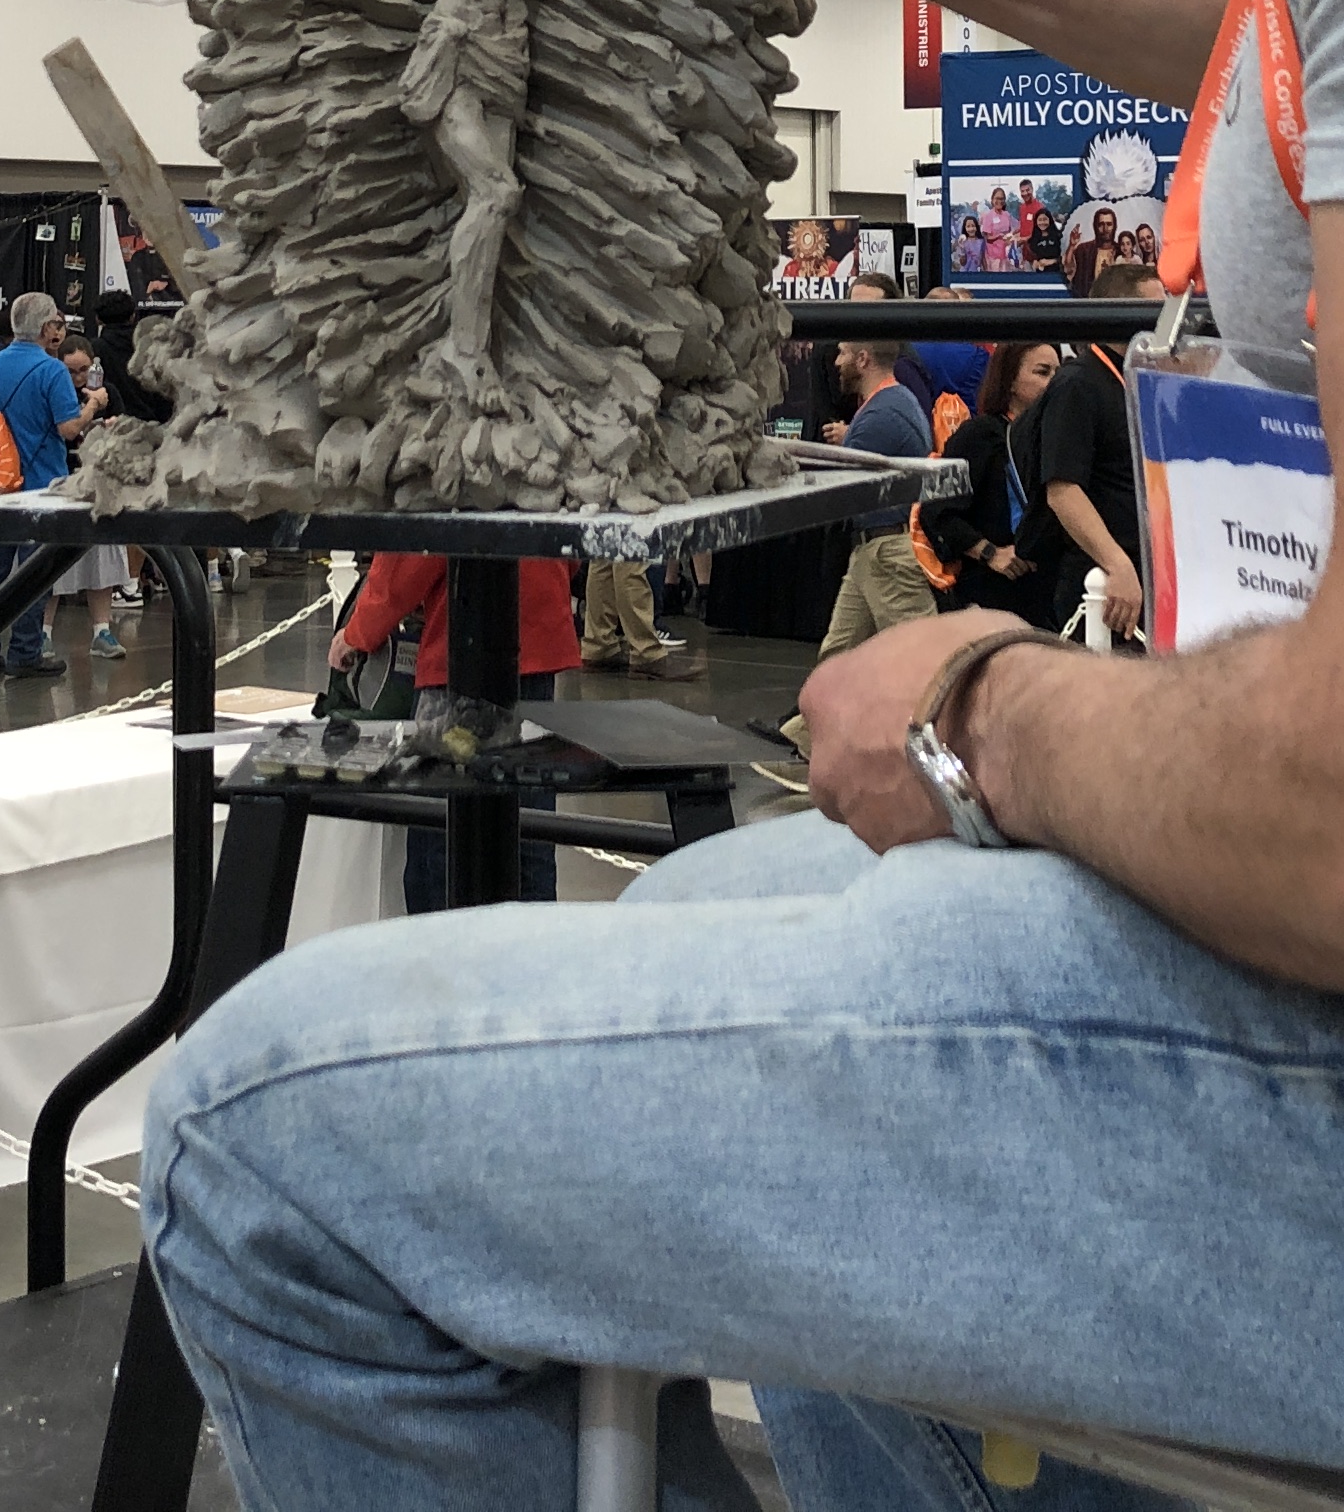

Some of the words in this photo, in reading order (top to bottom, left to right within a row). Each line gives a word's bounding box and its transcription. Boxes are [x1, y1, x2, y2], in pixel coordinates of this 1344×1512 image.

[1001, 72, 1122, 97] APOSTOL
[961, 100, 1052, 128] FAMILY
[1057, 97, 1193, 126] CONSECR
[764, 276, 857, 300] ETREAT
[1260, 416, 1292, 436] FULL
[1221, 518, 1318, 572] Timothy
